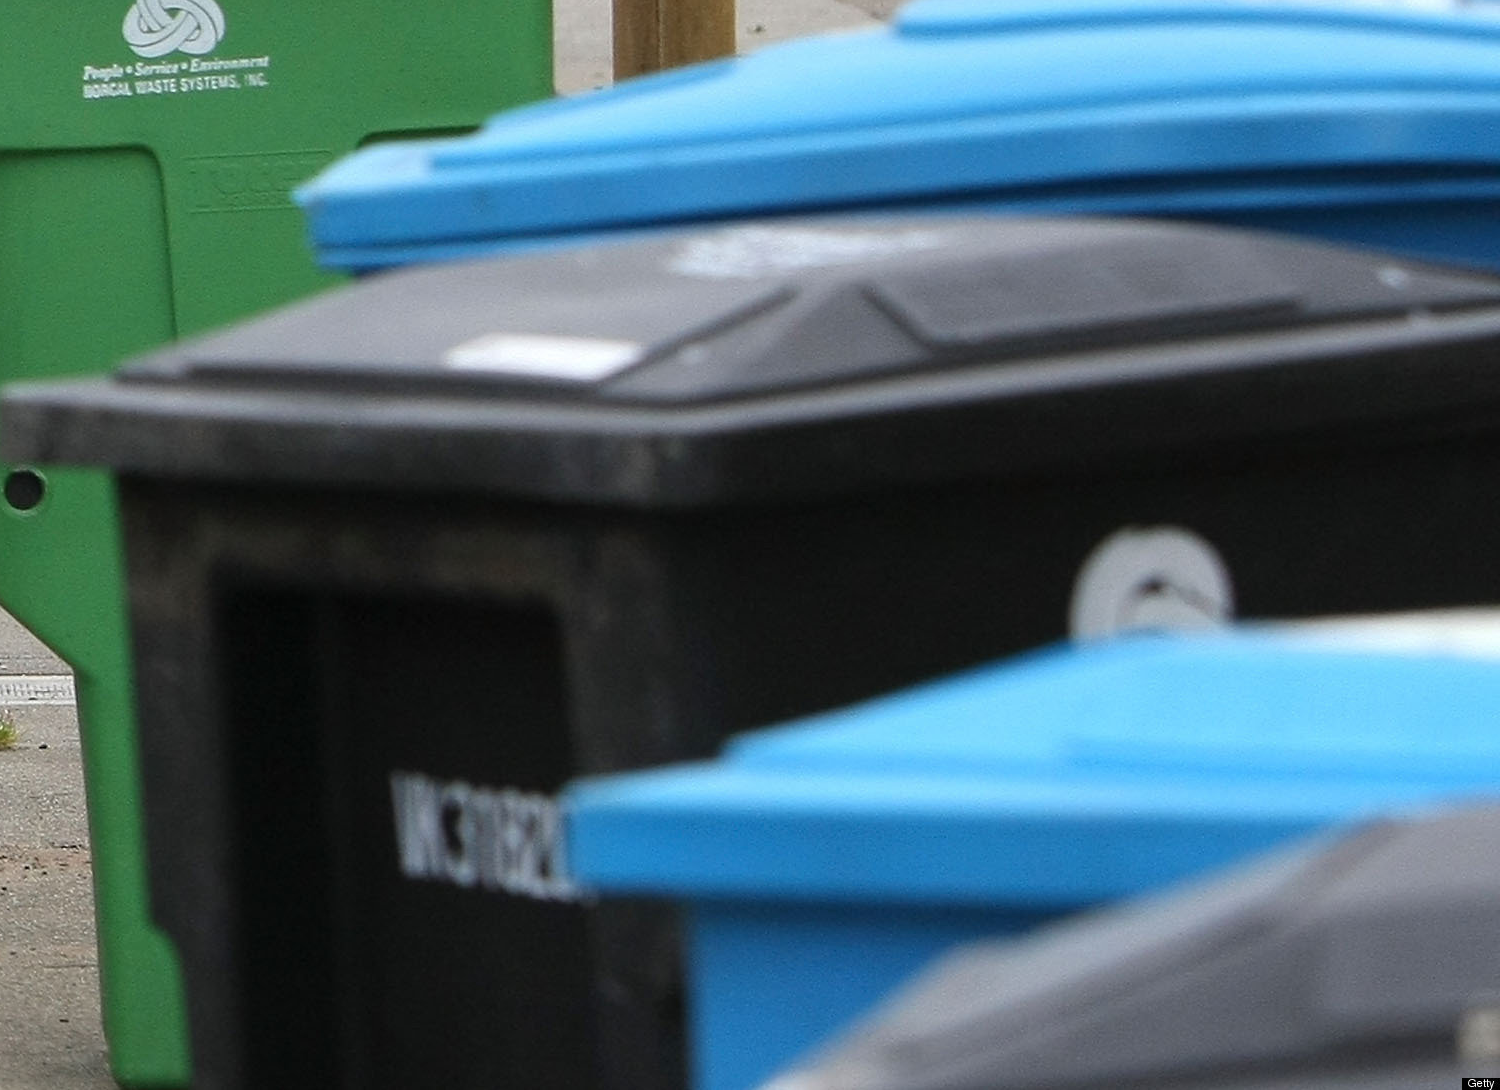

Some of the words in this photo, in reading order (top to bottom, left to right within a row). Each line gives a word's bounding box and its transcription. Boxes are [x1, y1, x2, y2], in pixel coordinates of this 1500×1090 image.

[83, 63, 125, 82] People
[134, 61, 179, 77] Service
[190, 56, 270, 74] Environment
[136, 78, 177, 95] WASTE
